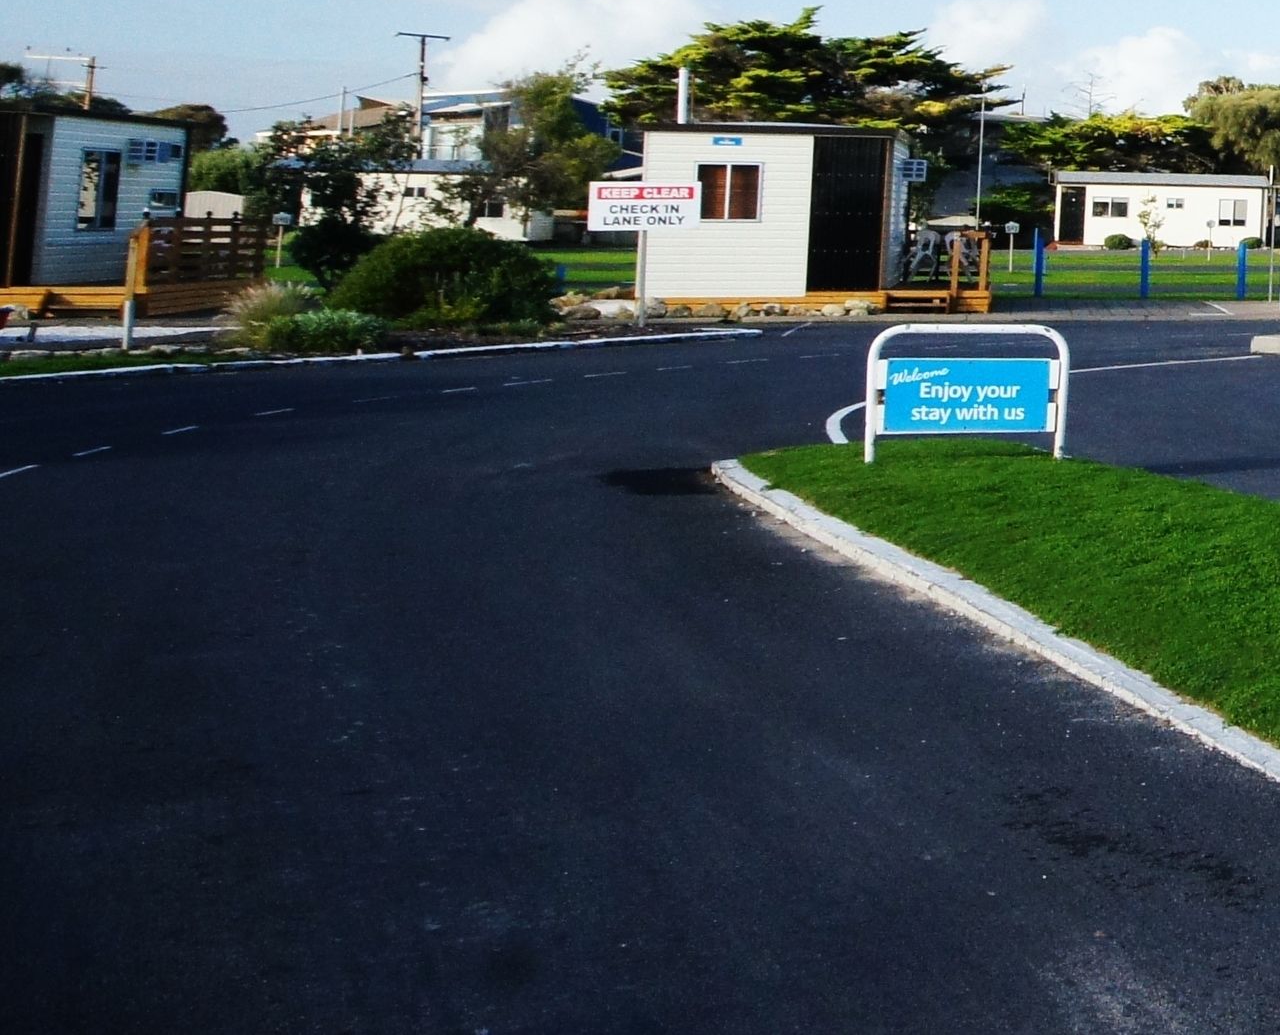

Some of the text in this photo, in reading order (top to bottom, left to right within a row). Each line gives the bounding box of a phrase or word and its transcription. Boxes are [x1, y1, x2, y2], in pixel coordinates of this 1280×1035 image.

[601, 188, 689, 198] KEEP CLEAR
[609, 204, 680, 214] CHECK IN
[603, 216, 685, 225] LANE ONLY
[889, 367, 950, 385] Welcome
[919, 382, 1020, 402] Enjoy your
[911, 404, 1025, 424] stay with us
